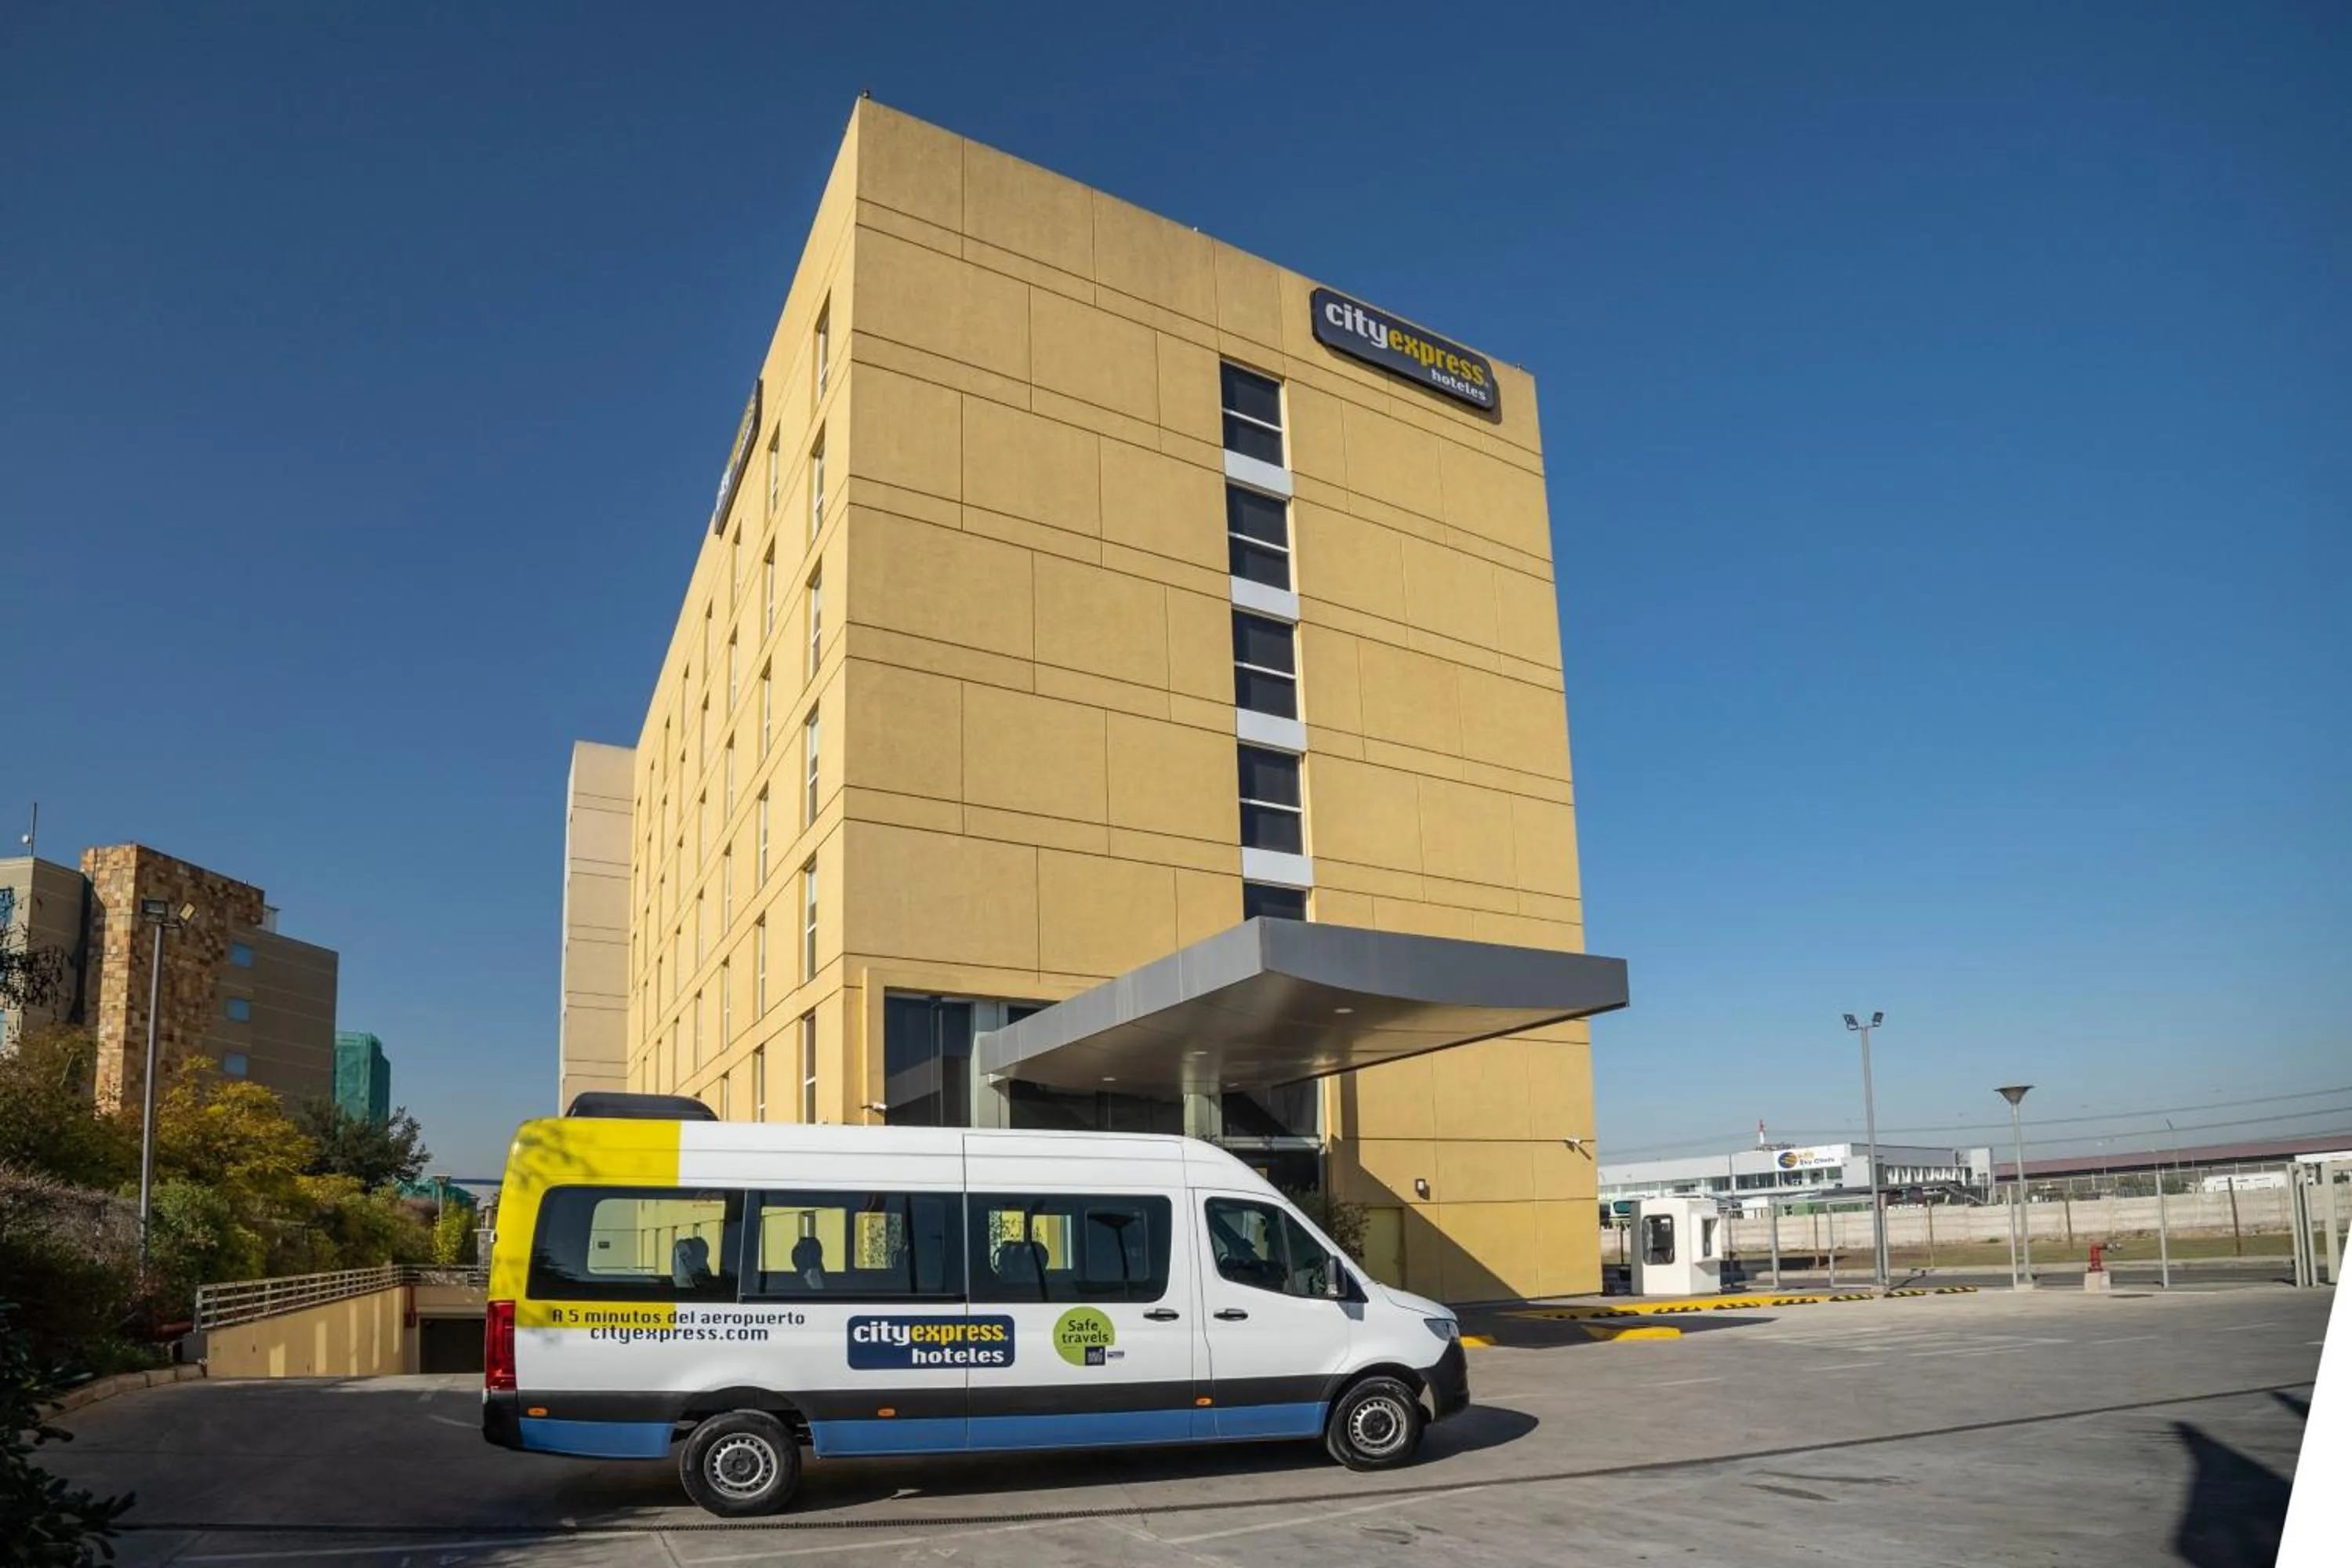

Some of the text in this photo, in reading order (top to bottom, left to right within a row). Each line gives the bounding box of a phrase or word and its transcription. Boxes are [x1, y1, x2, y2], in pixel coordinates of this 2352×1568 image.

[1325, 303, 1485, 386] cityexpress
[1432, 368, 1486, 401] hoteles
[569, 1310, 579, 1323] 5
[584, 1310, 661, 1323] minutos
[667, 1310, 695, 1324] del
[701, 1311, 805, 1326] aeropuerto
[1068, 1318, 1098, 1332] Safe
[590, 1325, 768, 1344] cityexpress.com
[853, 1321, 1004, 1346] cityexpress
[1062, 1330, 1109, 1344] travels
[912, 1348, 1004, 1364] hoteles
